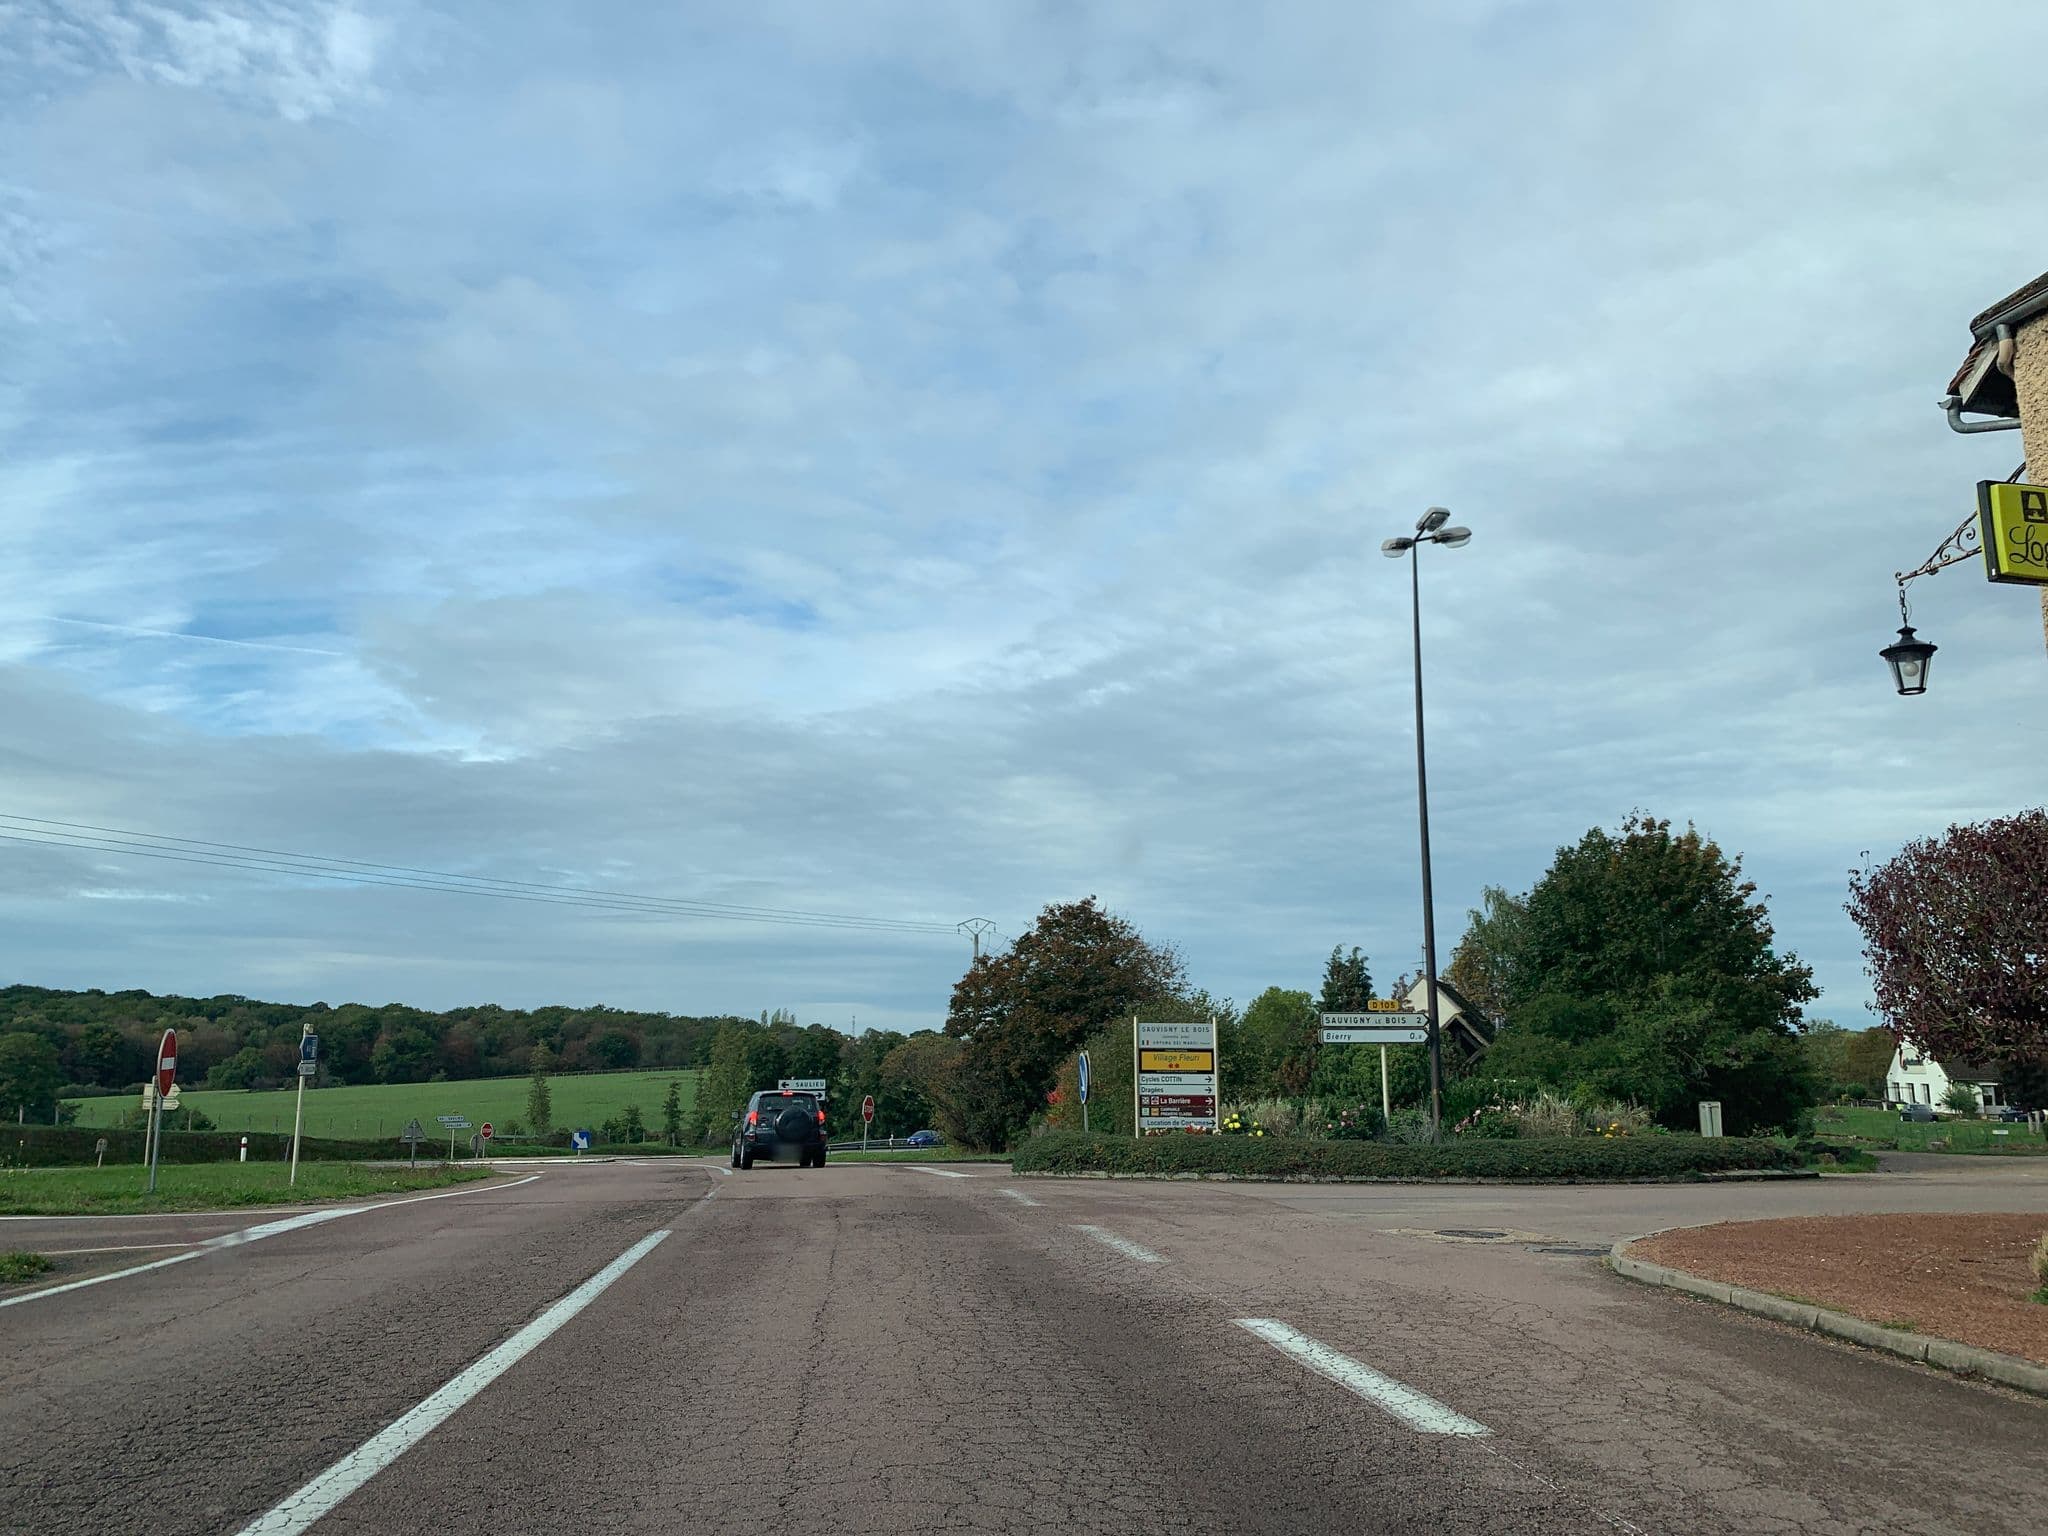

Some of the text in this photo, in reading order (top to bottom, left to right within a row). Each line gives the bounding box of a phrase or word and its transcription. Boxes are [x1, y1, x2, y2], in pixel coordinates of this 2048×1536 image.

[1326, 1033, 1352, 1041] Bierry
[1153, 1053, 1200, 1062] Village Fleuri
[1141, 1086, 1164, 1094] Dragées
